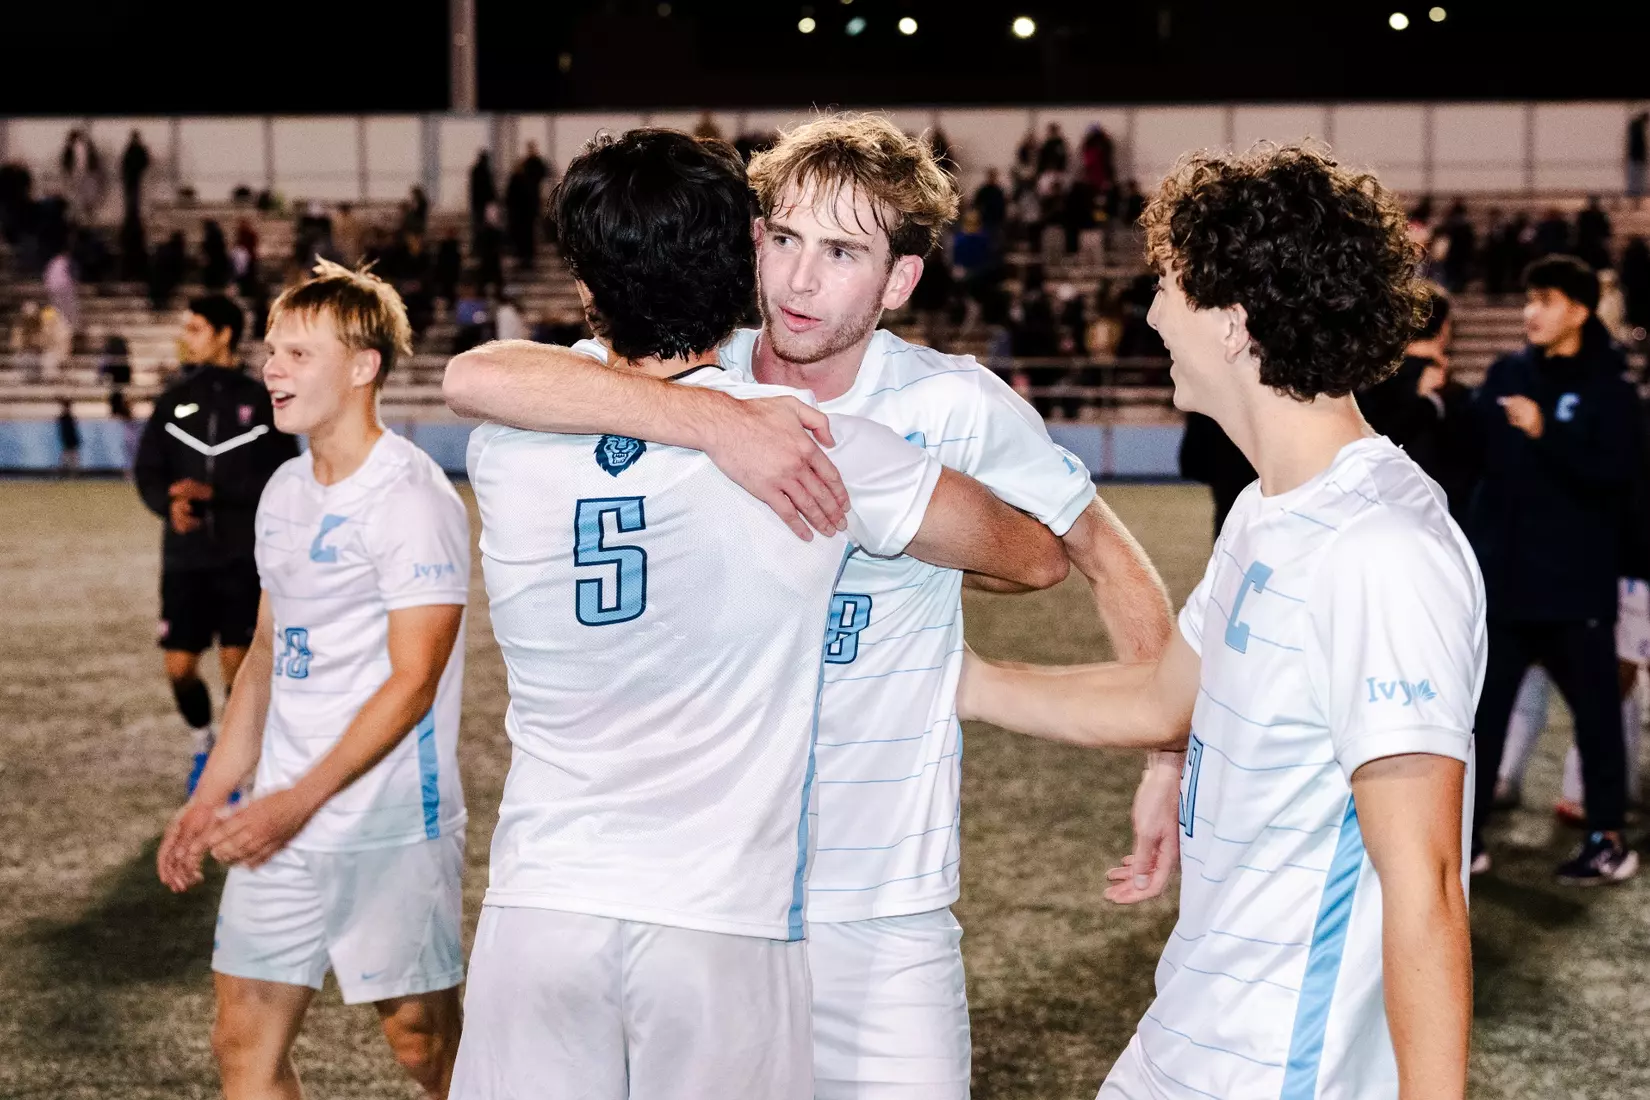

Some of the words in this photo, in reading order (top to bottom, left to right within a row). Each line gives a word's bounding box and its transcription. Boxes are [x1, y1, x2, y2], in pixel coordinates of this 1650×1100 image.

[574, 496, 647, 627] 5
[1225, 561, 1274, 654] C
[1366, 677, 1411, 706] Ivy
